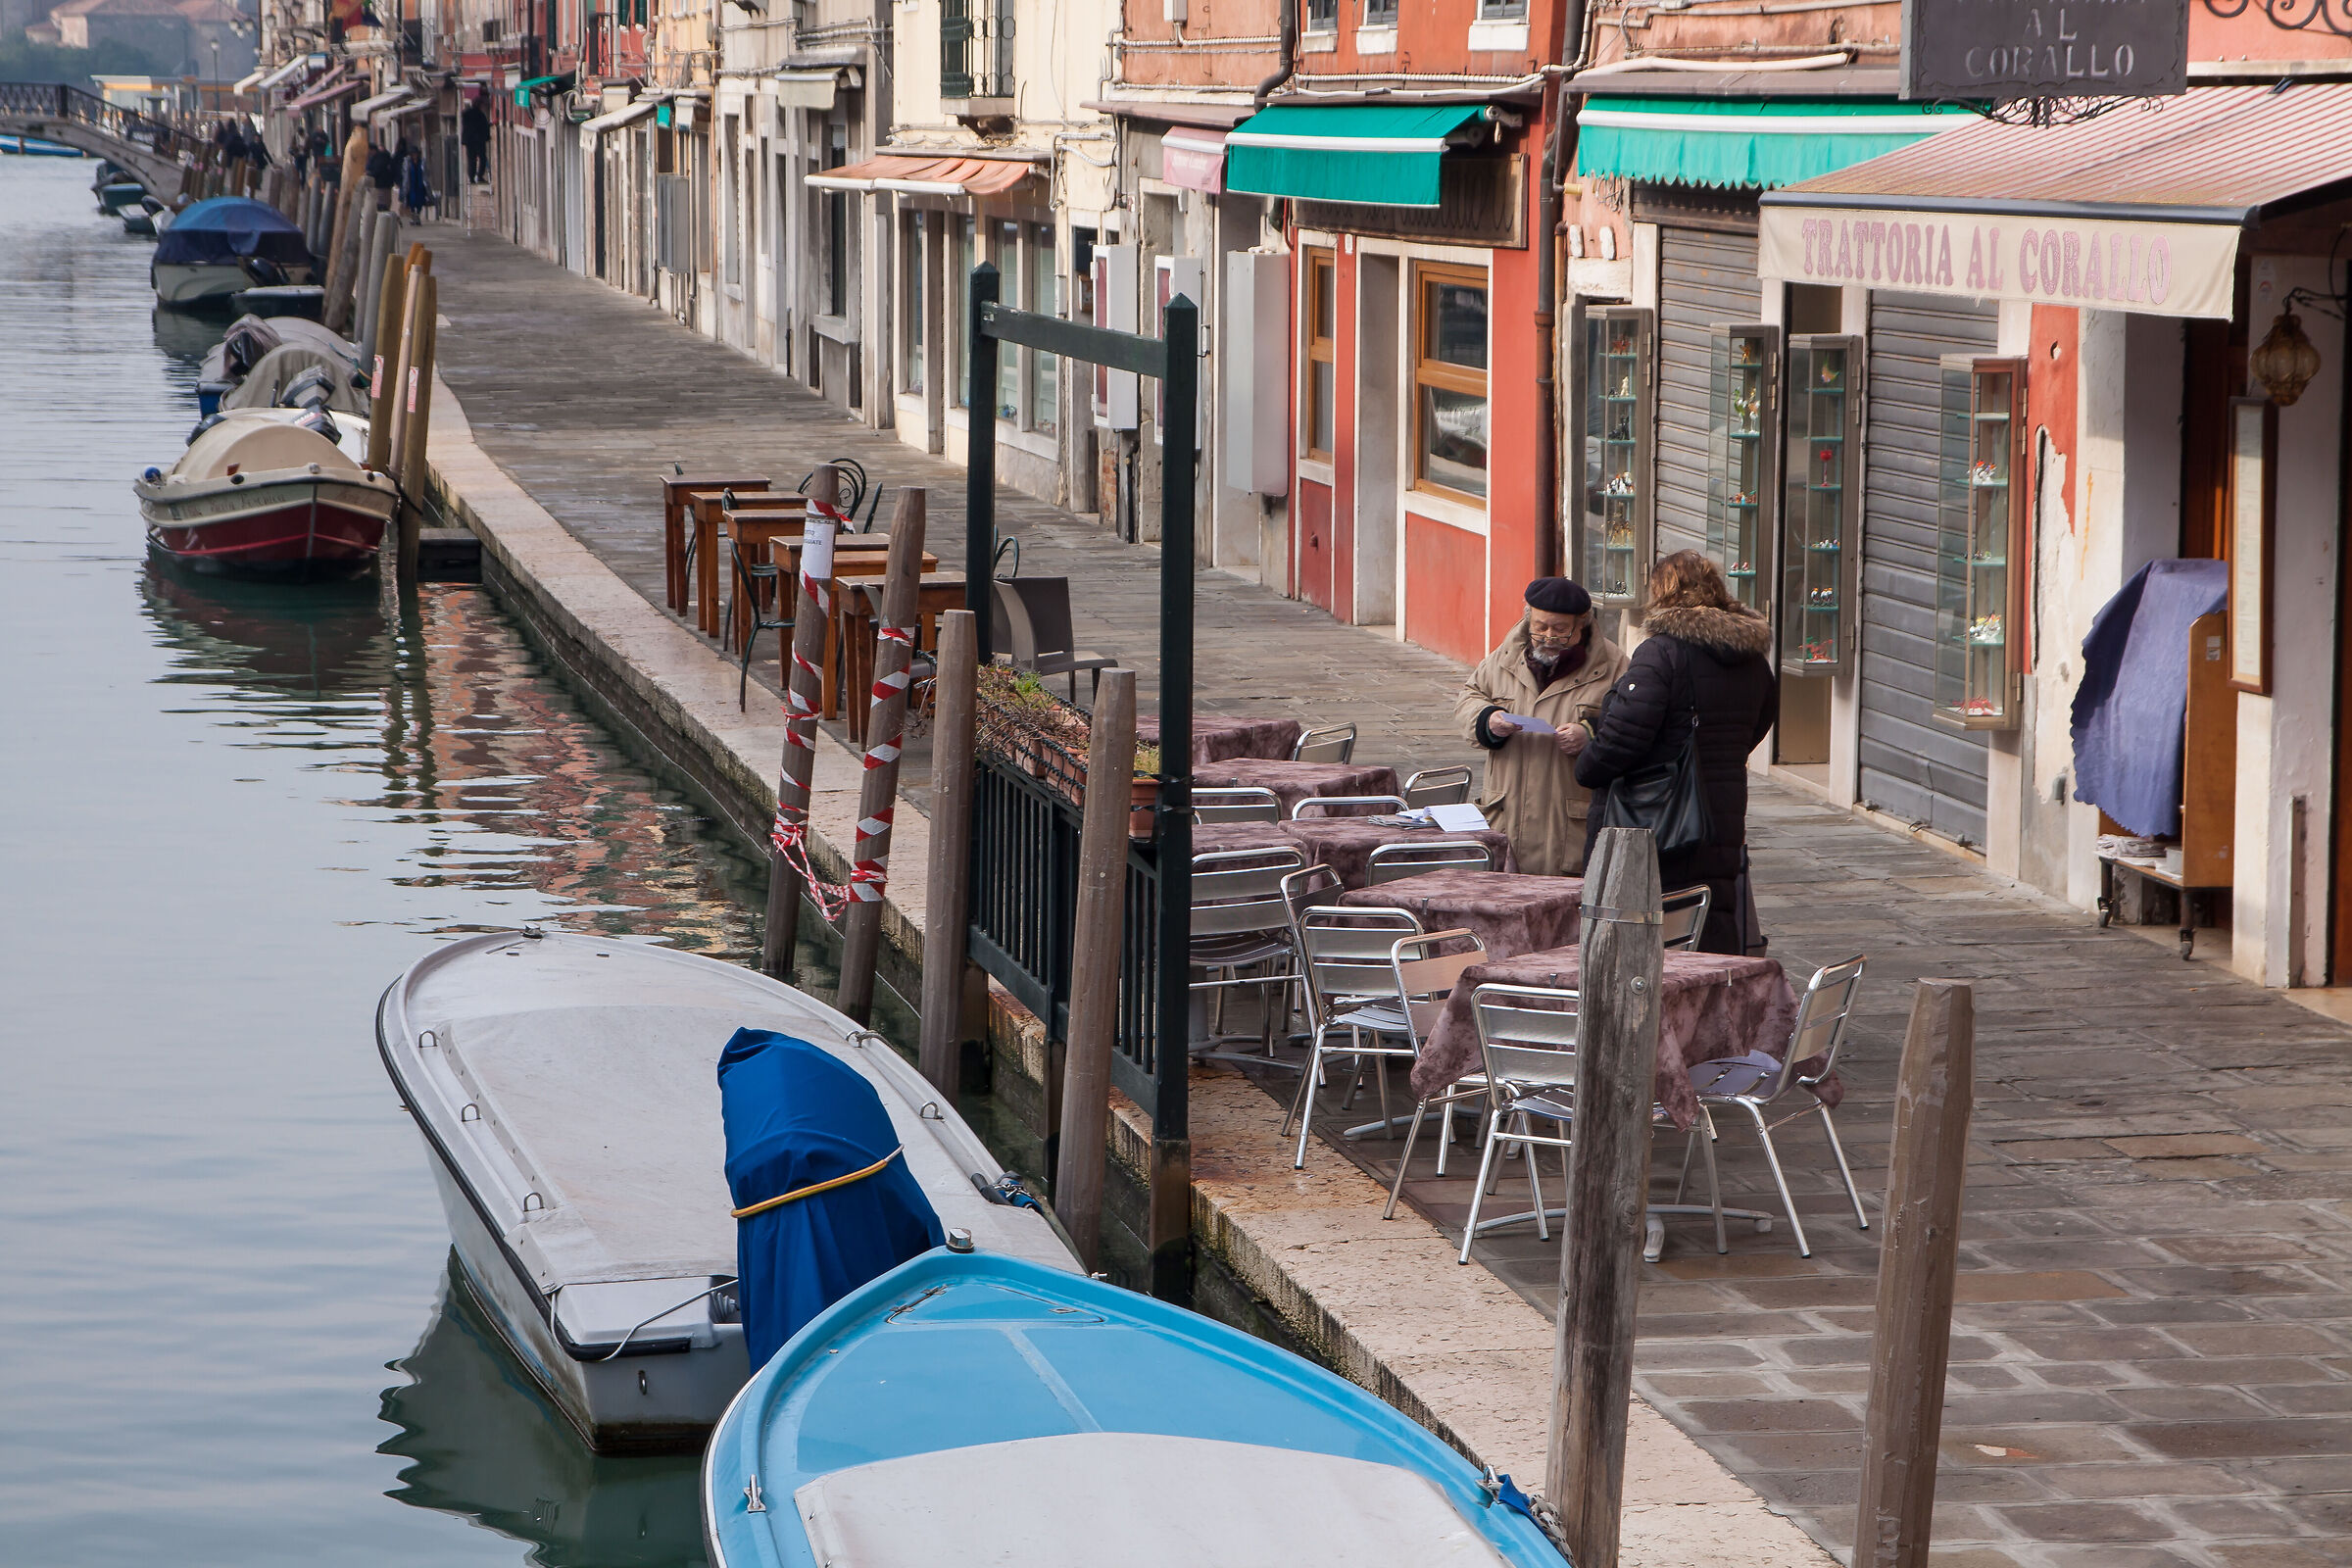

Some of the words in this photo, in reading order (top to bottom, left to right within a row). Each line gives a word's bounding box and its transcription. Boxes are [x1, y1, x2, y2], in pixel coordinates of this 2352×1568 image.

[2023, 8, 2078, 42] AL
[1965, 44, 2134, 77] CORALLO
[1802, 218, 1954, 286] TRATTORIA
[1966, 225, 2004, 291] AL
[2019, 227, 2172, 305] CORALLO
